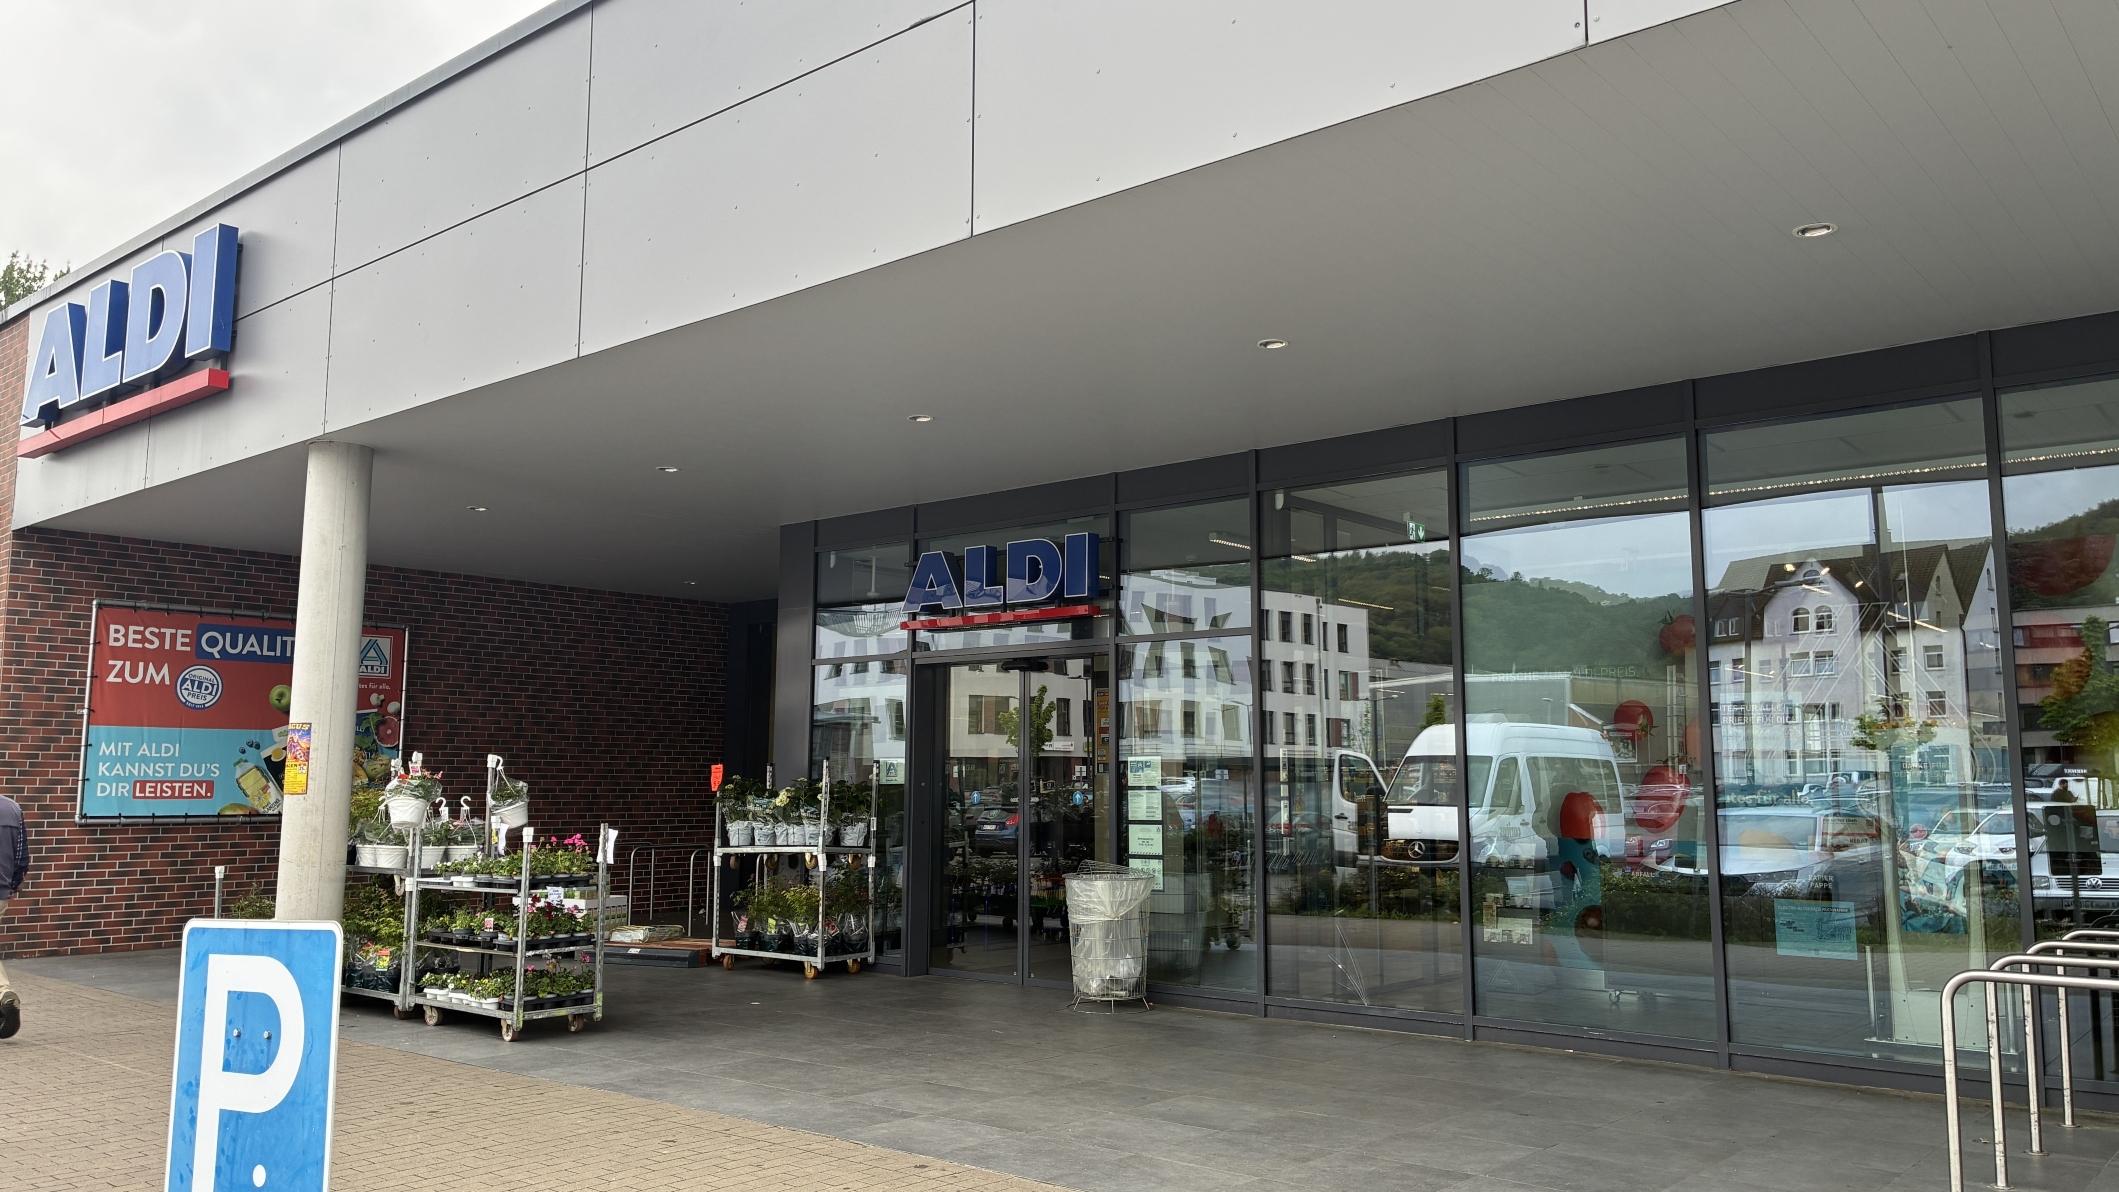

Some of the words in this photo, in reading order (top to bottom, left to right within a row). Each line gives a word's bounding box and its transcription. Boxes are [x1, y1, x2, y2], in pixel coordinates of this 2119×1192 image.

[20, 223, 239, 427] ALDI
[900, 532, 1099, 614] ALDI
[108, 624, 192, 651] BESTE
[106, 660, 170, 685] ZUM
[360, 665, 386, 674] ALDI
[181, 678, 218, 696] ALDI
[186, 692, 208, 701] PREIS
[98, 742, 133, 757] MIT
[137, 743, 180, 757] ALDI
[98, 762, 175, 777] KANNST
[96, 782, 130, 797] DIR
[135, 782, 212, 797] LEISTEN.
[191, 953, 305, 1192] P
